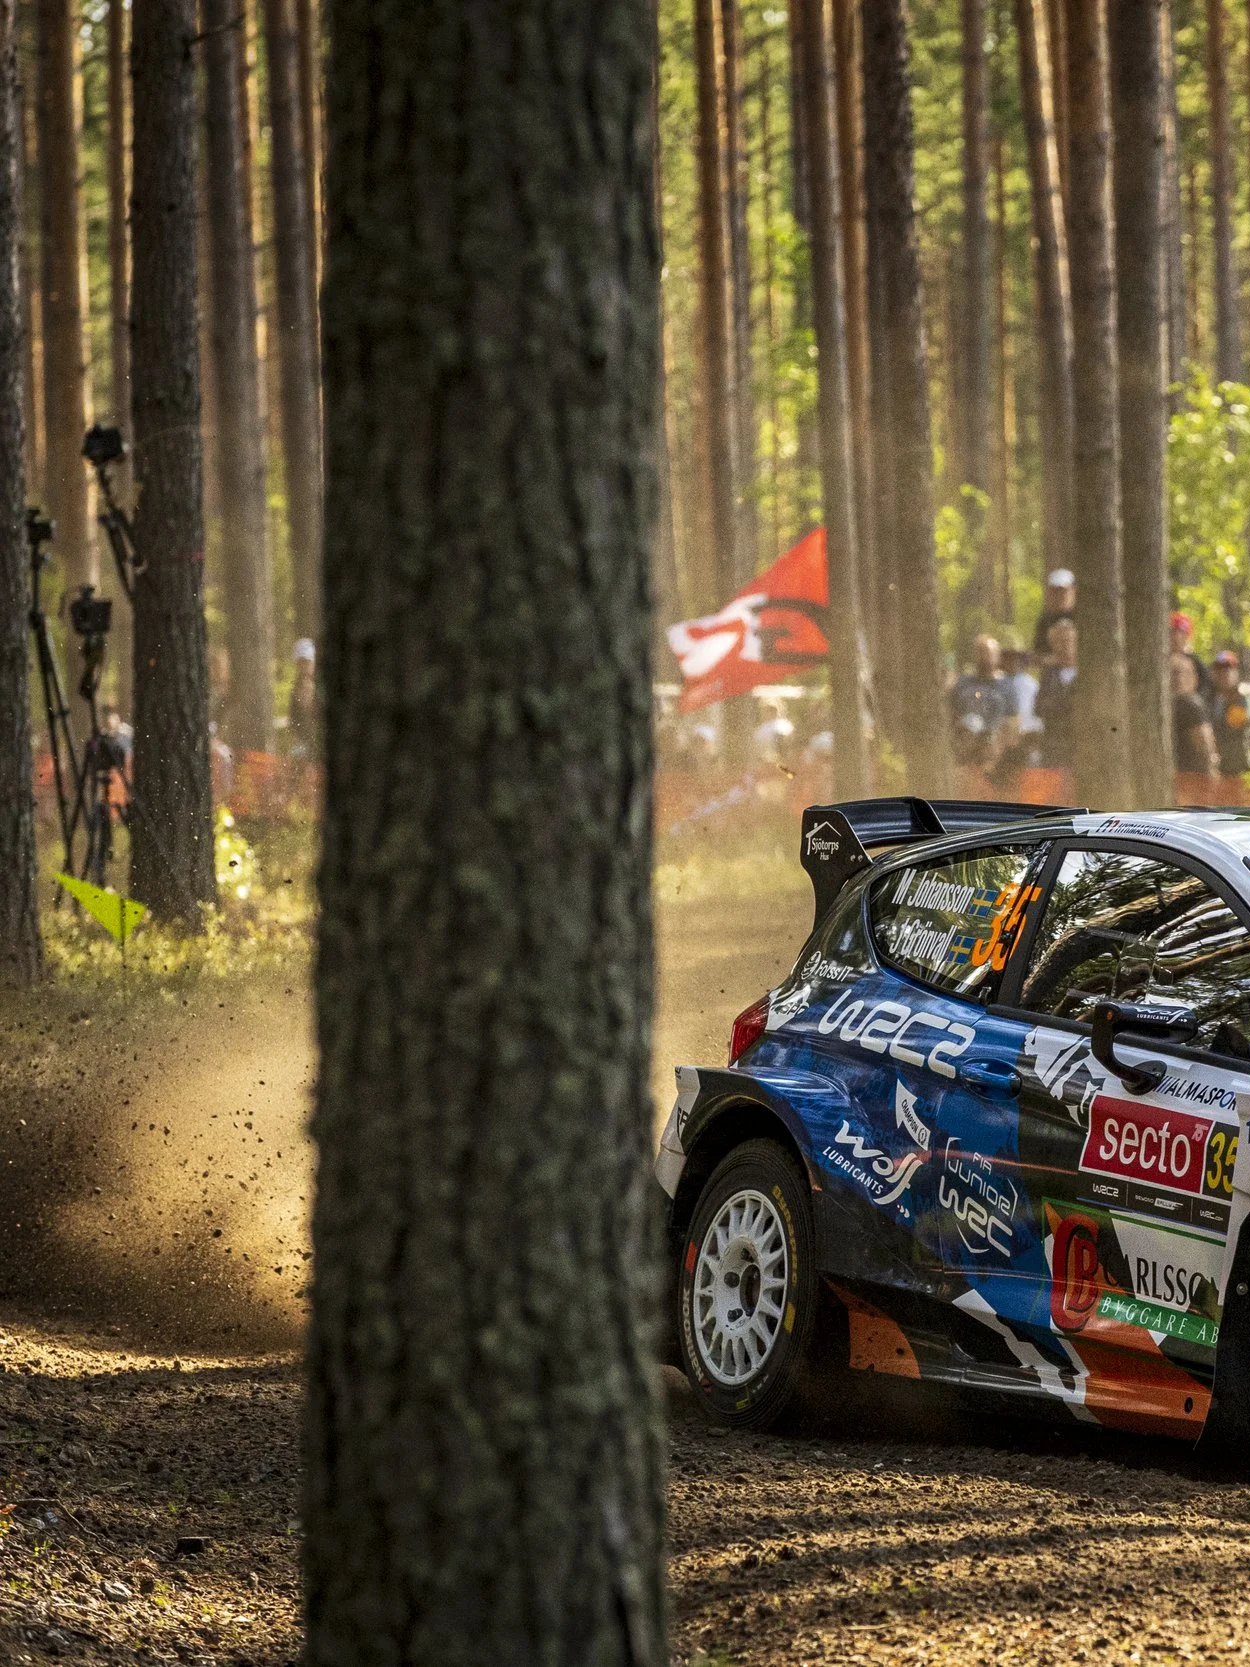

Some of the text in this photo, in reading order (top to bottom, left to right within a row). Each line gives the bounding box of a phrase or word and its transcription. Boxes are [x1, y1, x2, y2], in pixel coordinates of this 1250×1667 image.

[811, 838, 839, 854] Sjötorps
[891, 868, 975, 914] M Johansson
[901, 918, 958, 961] Grönvall
[971, 882, 1043, 972] 35
[815, 960, 854, 982] Forss IT
[817, 988, 976, 1080] WRC2
[1136, 1013, 1169, 1021] LUBRICANTS
[901, 1098, 919, 1133] CHAMPION
[822, 1146, 884, 1195] LUBRICANTS
[973, 1151, 992, 1175] FIA
[1099, 1117, 1191, 1178] secto
[1206, 1131, 1239, 1194] 35
[948, 1159, 1011, 1217] JUNIOR
[939, 1175, 1013, 1257] WRC
[1100, 1296, 1220, 1344] BYGGARE AB
